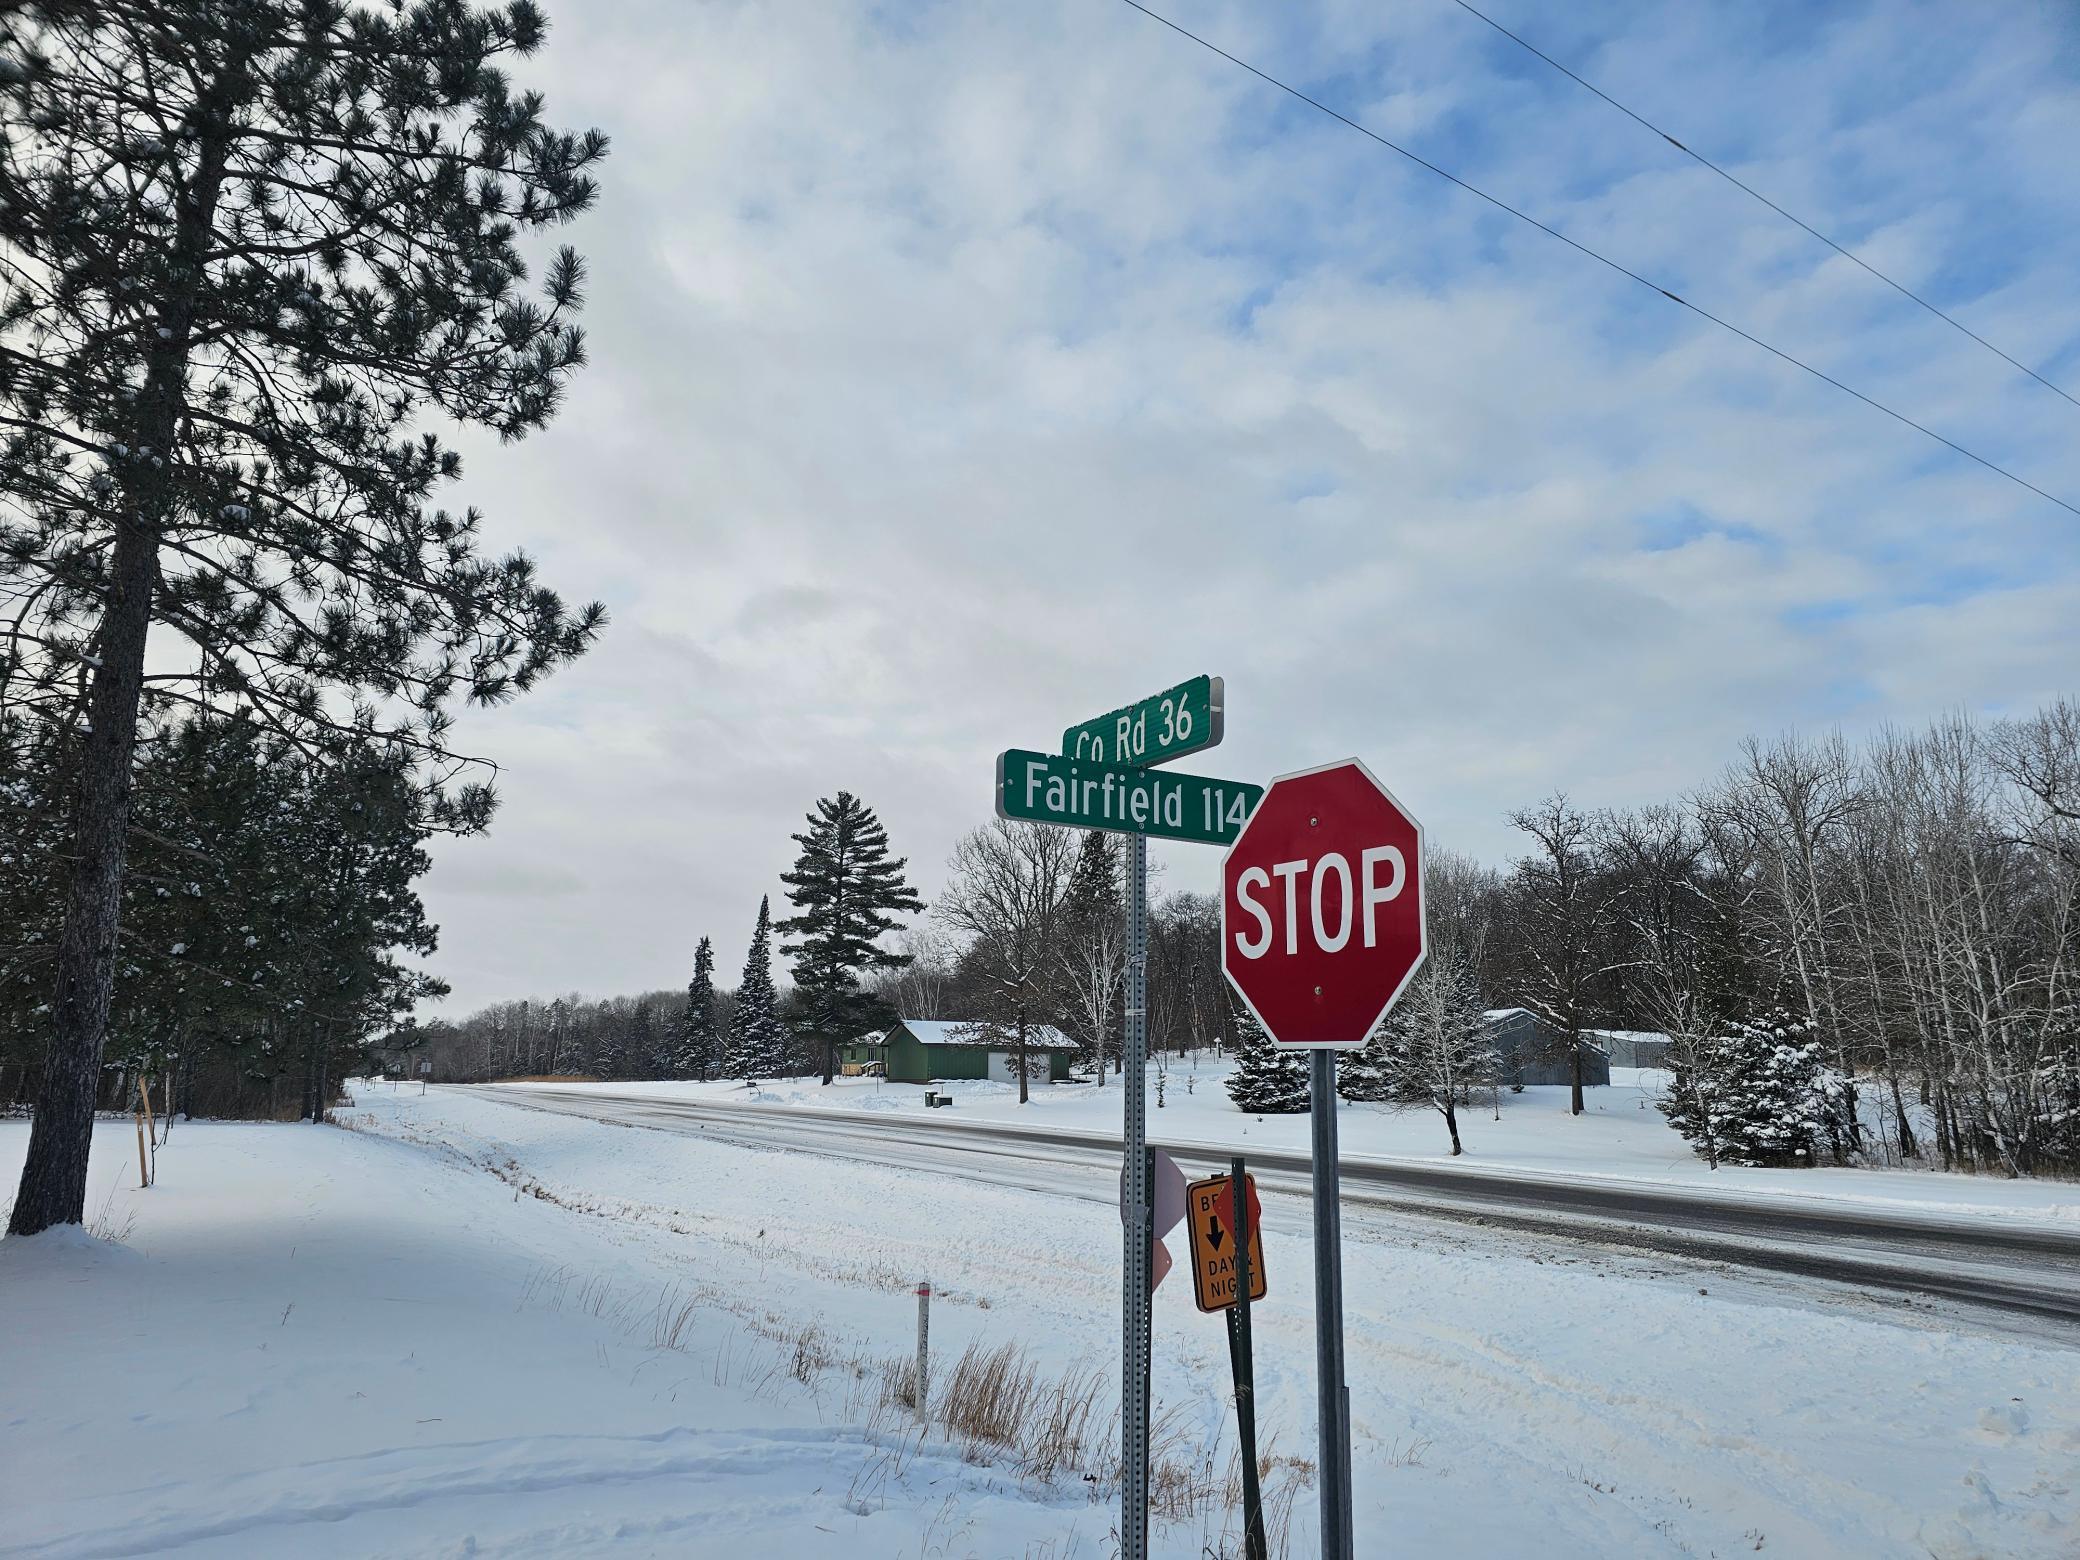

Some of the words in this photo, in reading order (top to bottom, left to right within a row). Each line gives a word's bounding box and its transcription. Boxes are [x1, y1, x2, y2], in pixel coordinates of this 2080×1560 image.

[1076, 731, 1104, 762] Co
[1116, 709, 1146, 762] Rd
[1158, 691, 1193, 746] 36
[1026, 761, 1182, 827] Fairfield
[1202, 787, 1248, 833] 114
[1235, 845, 1406, 960] STOP
[1208, 1254, 1236, 1276] DAY
[1210, 1272, 1255, 1298] NIGT
